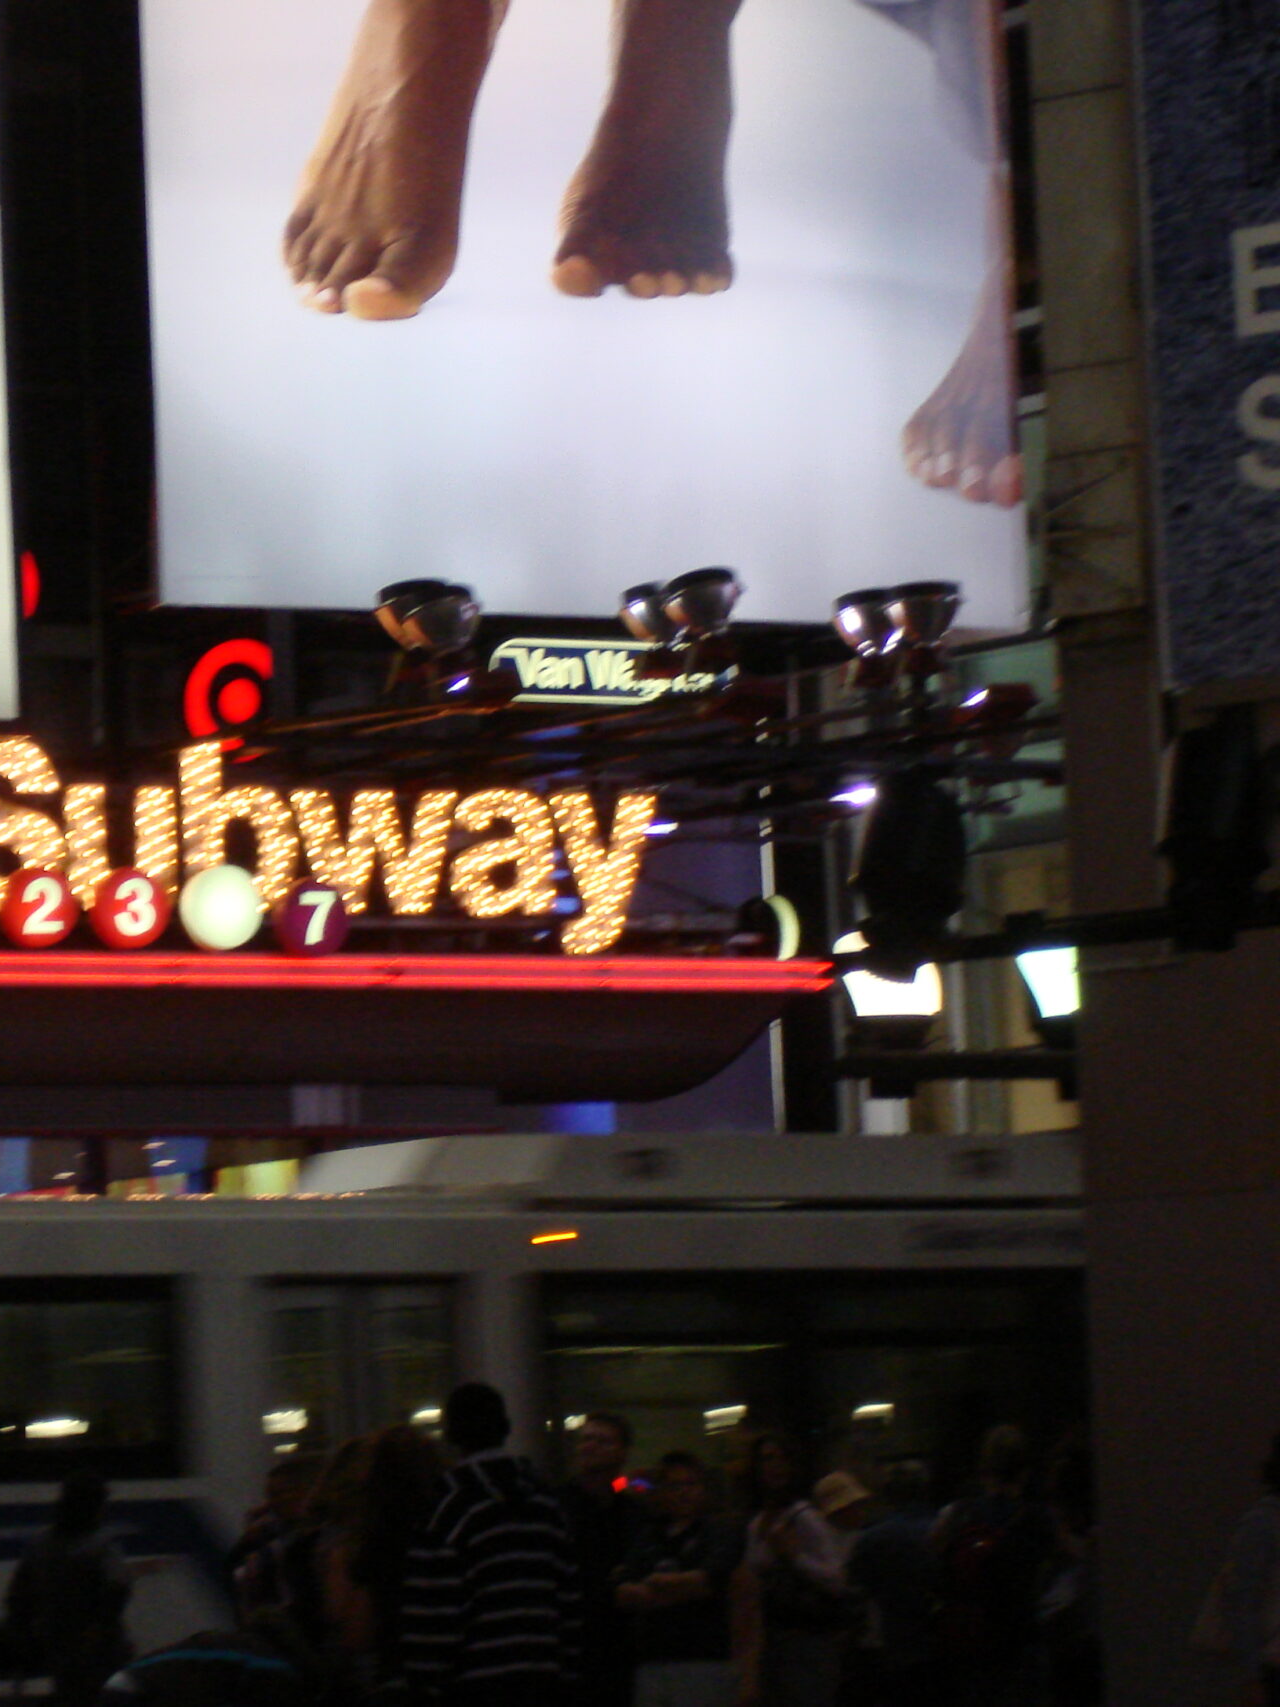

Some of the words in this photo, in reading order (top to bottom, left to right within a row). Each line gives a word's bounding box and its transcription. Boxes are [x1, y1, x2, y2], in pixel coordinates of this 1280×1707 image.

[512, 648, 586, 690] Van
[21, 876, 65, 935] 2
[113, 877, 158, 937] 3
[299, 889, 337, 945] 7
